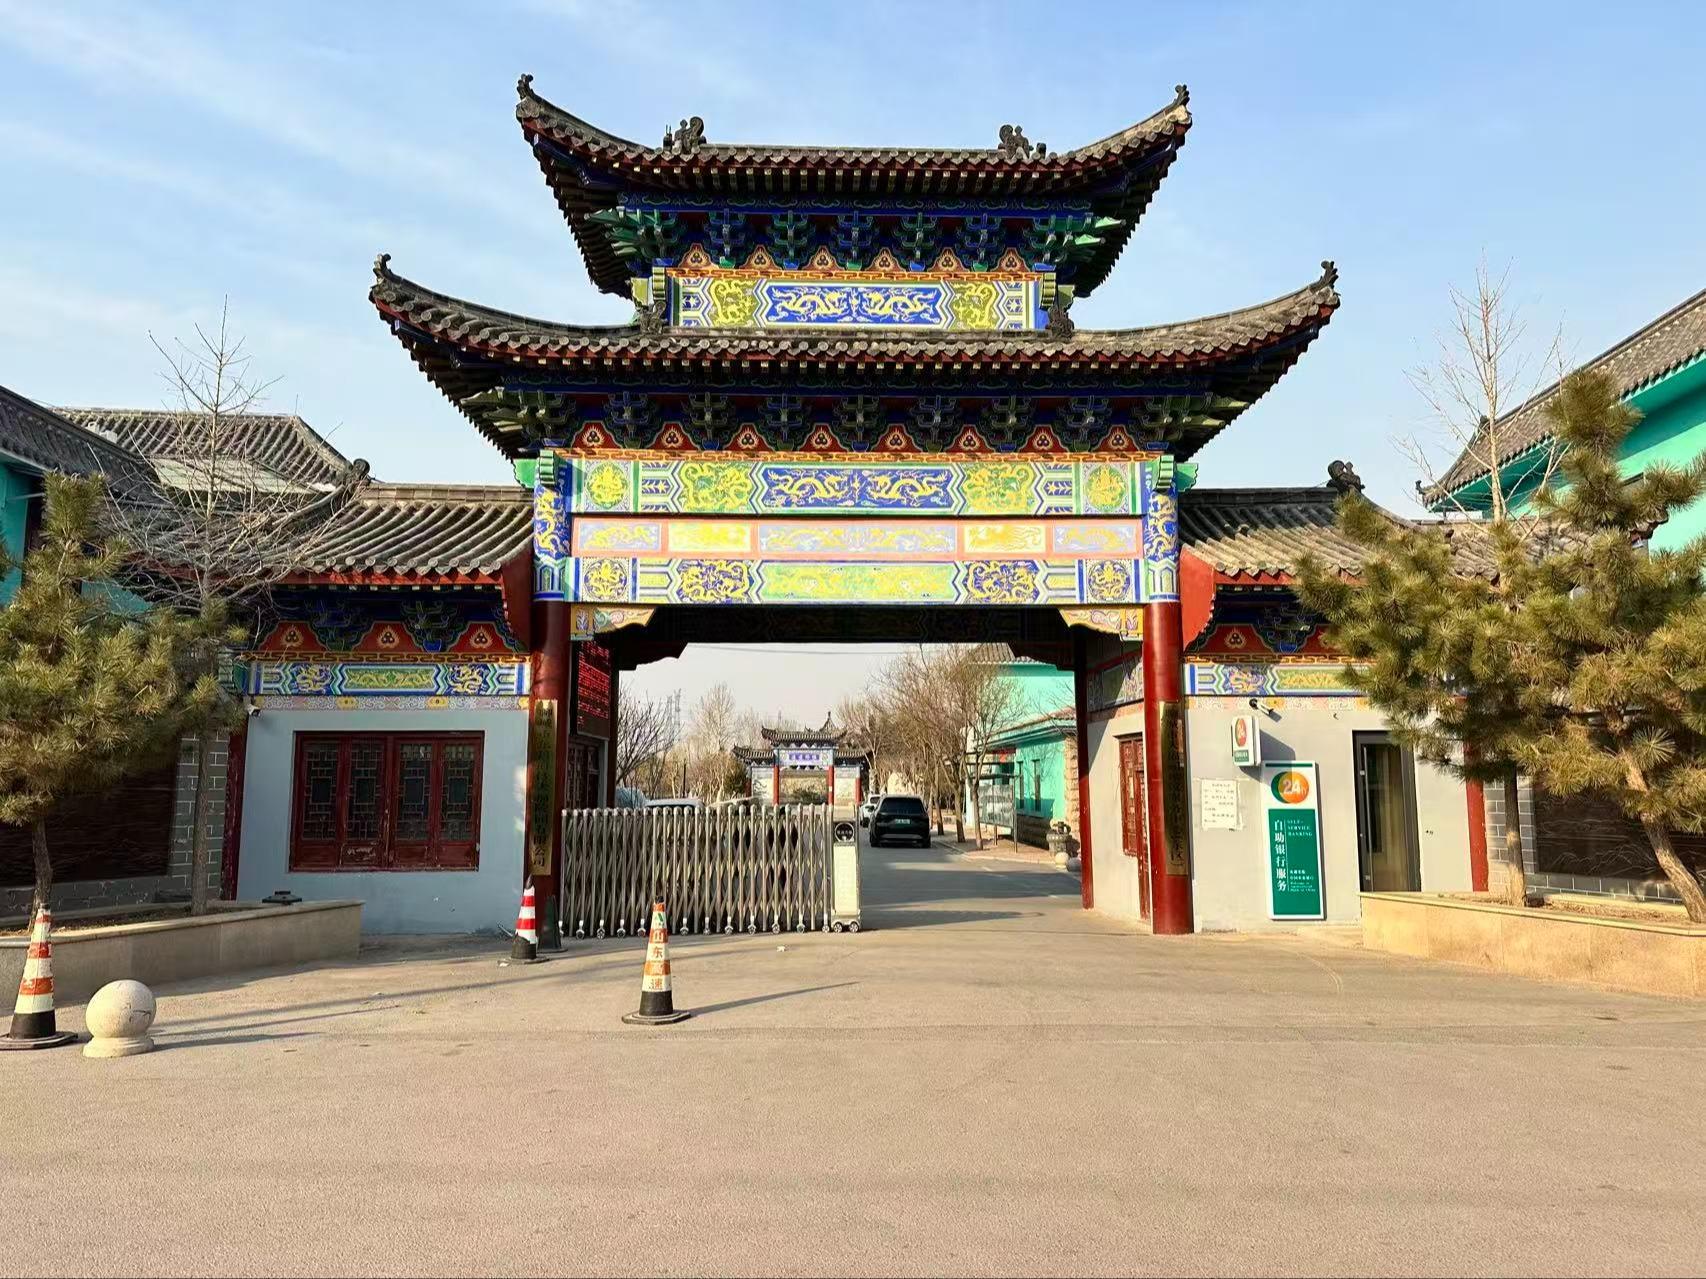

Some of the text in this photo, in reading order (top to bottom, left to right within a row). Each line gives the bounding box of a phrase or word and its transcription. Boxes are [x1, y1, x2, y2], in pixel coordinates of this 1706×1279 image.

[1274, 819, 1287, 891] 自助银行服务
[651, 929, 664, 990] 山东高速
